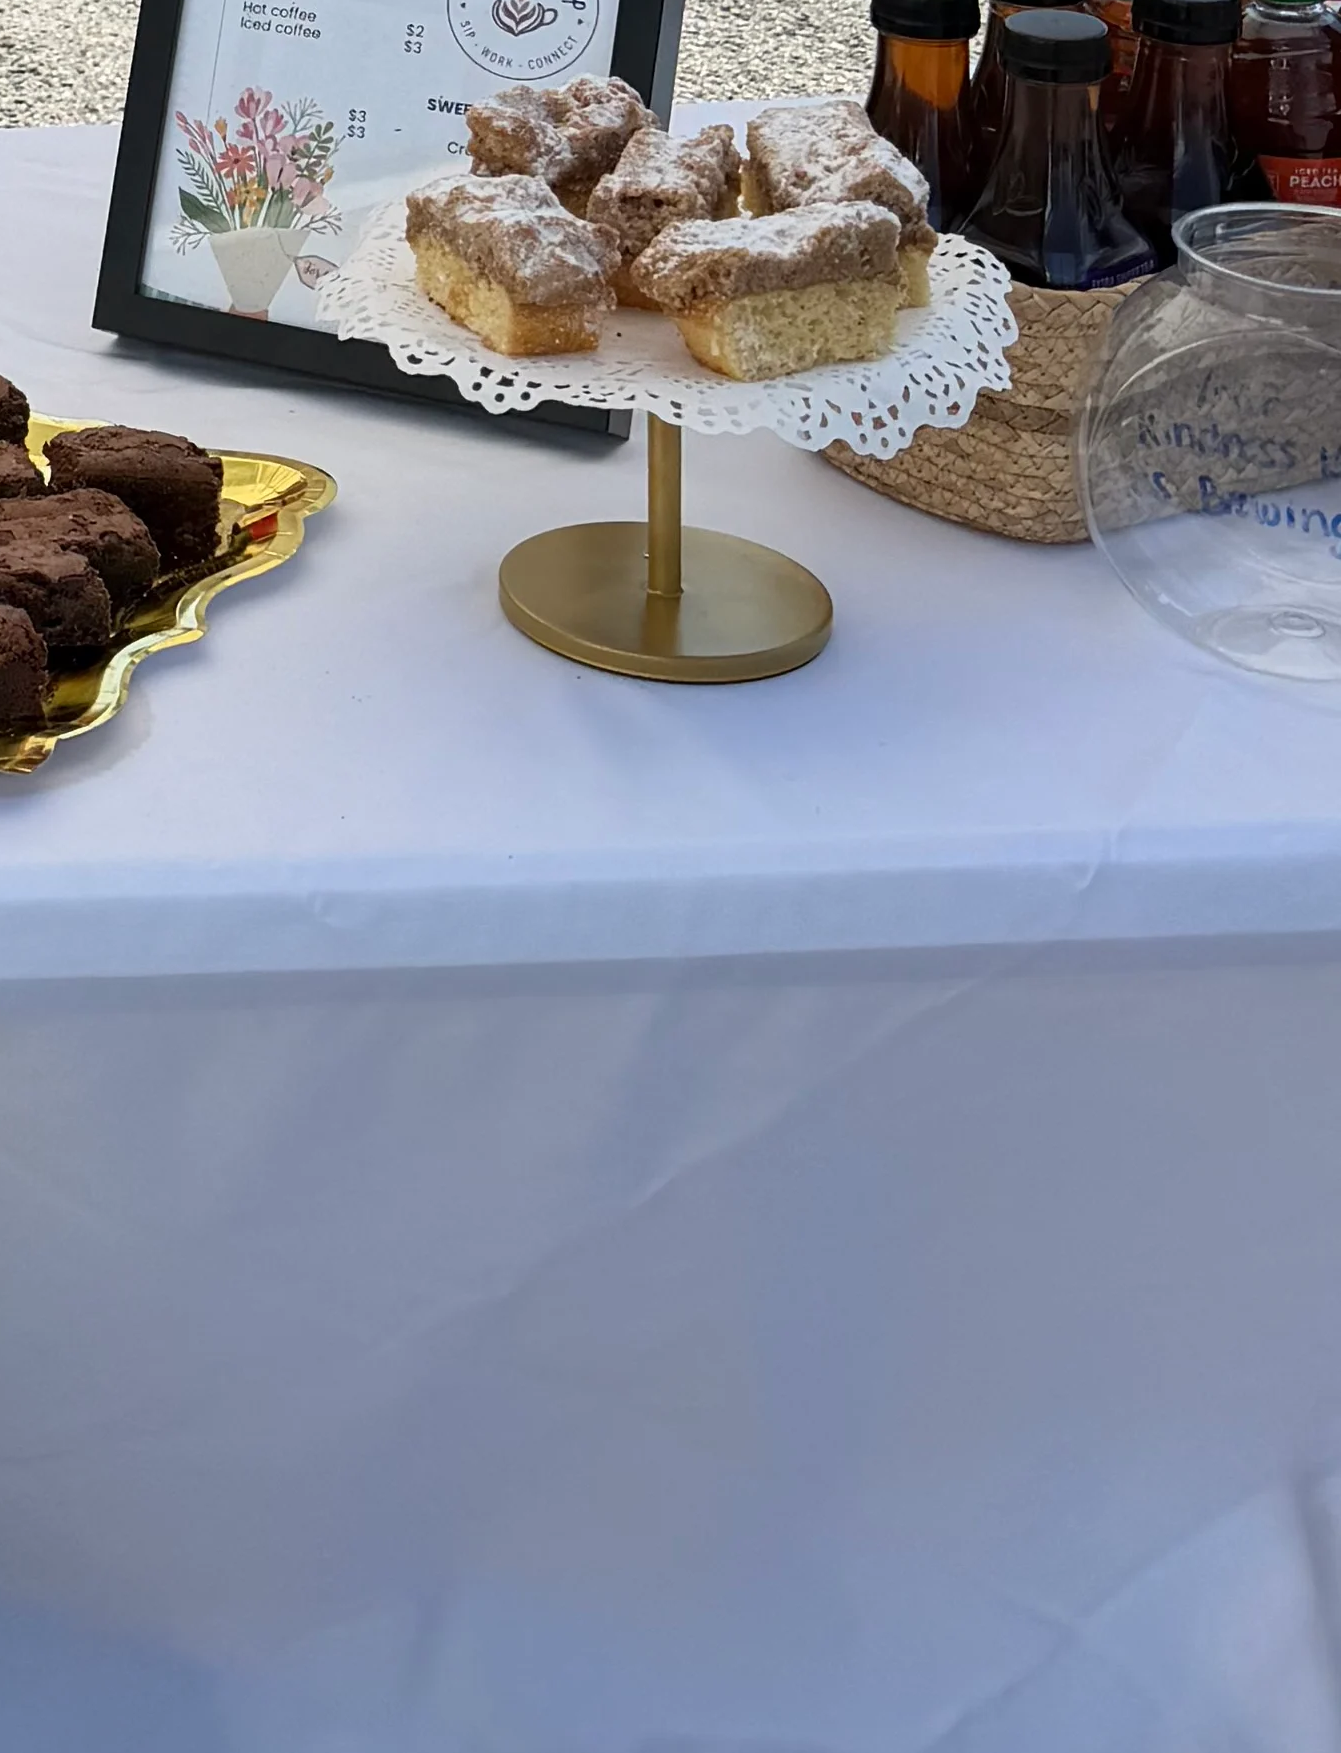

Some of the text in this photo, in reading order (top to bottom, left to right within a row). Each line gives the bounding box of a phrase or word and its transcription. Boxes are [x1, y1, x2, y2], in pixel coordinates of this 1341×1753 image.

[242, 0, 318, 23] Hot coffee
[240, 15, 322, 40] Iced coffee
[405, 22, 425, 39] $2
[403, 39, 423, 55] $3
[460, 19, 579, 71] SIP WORK CONNECT
[348, 108, 367, 123] $3
[347, 124, 366, 139] $3
